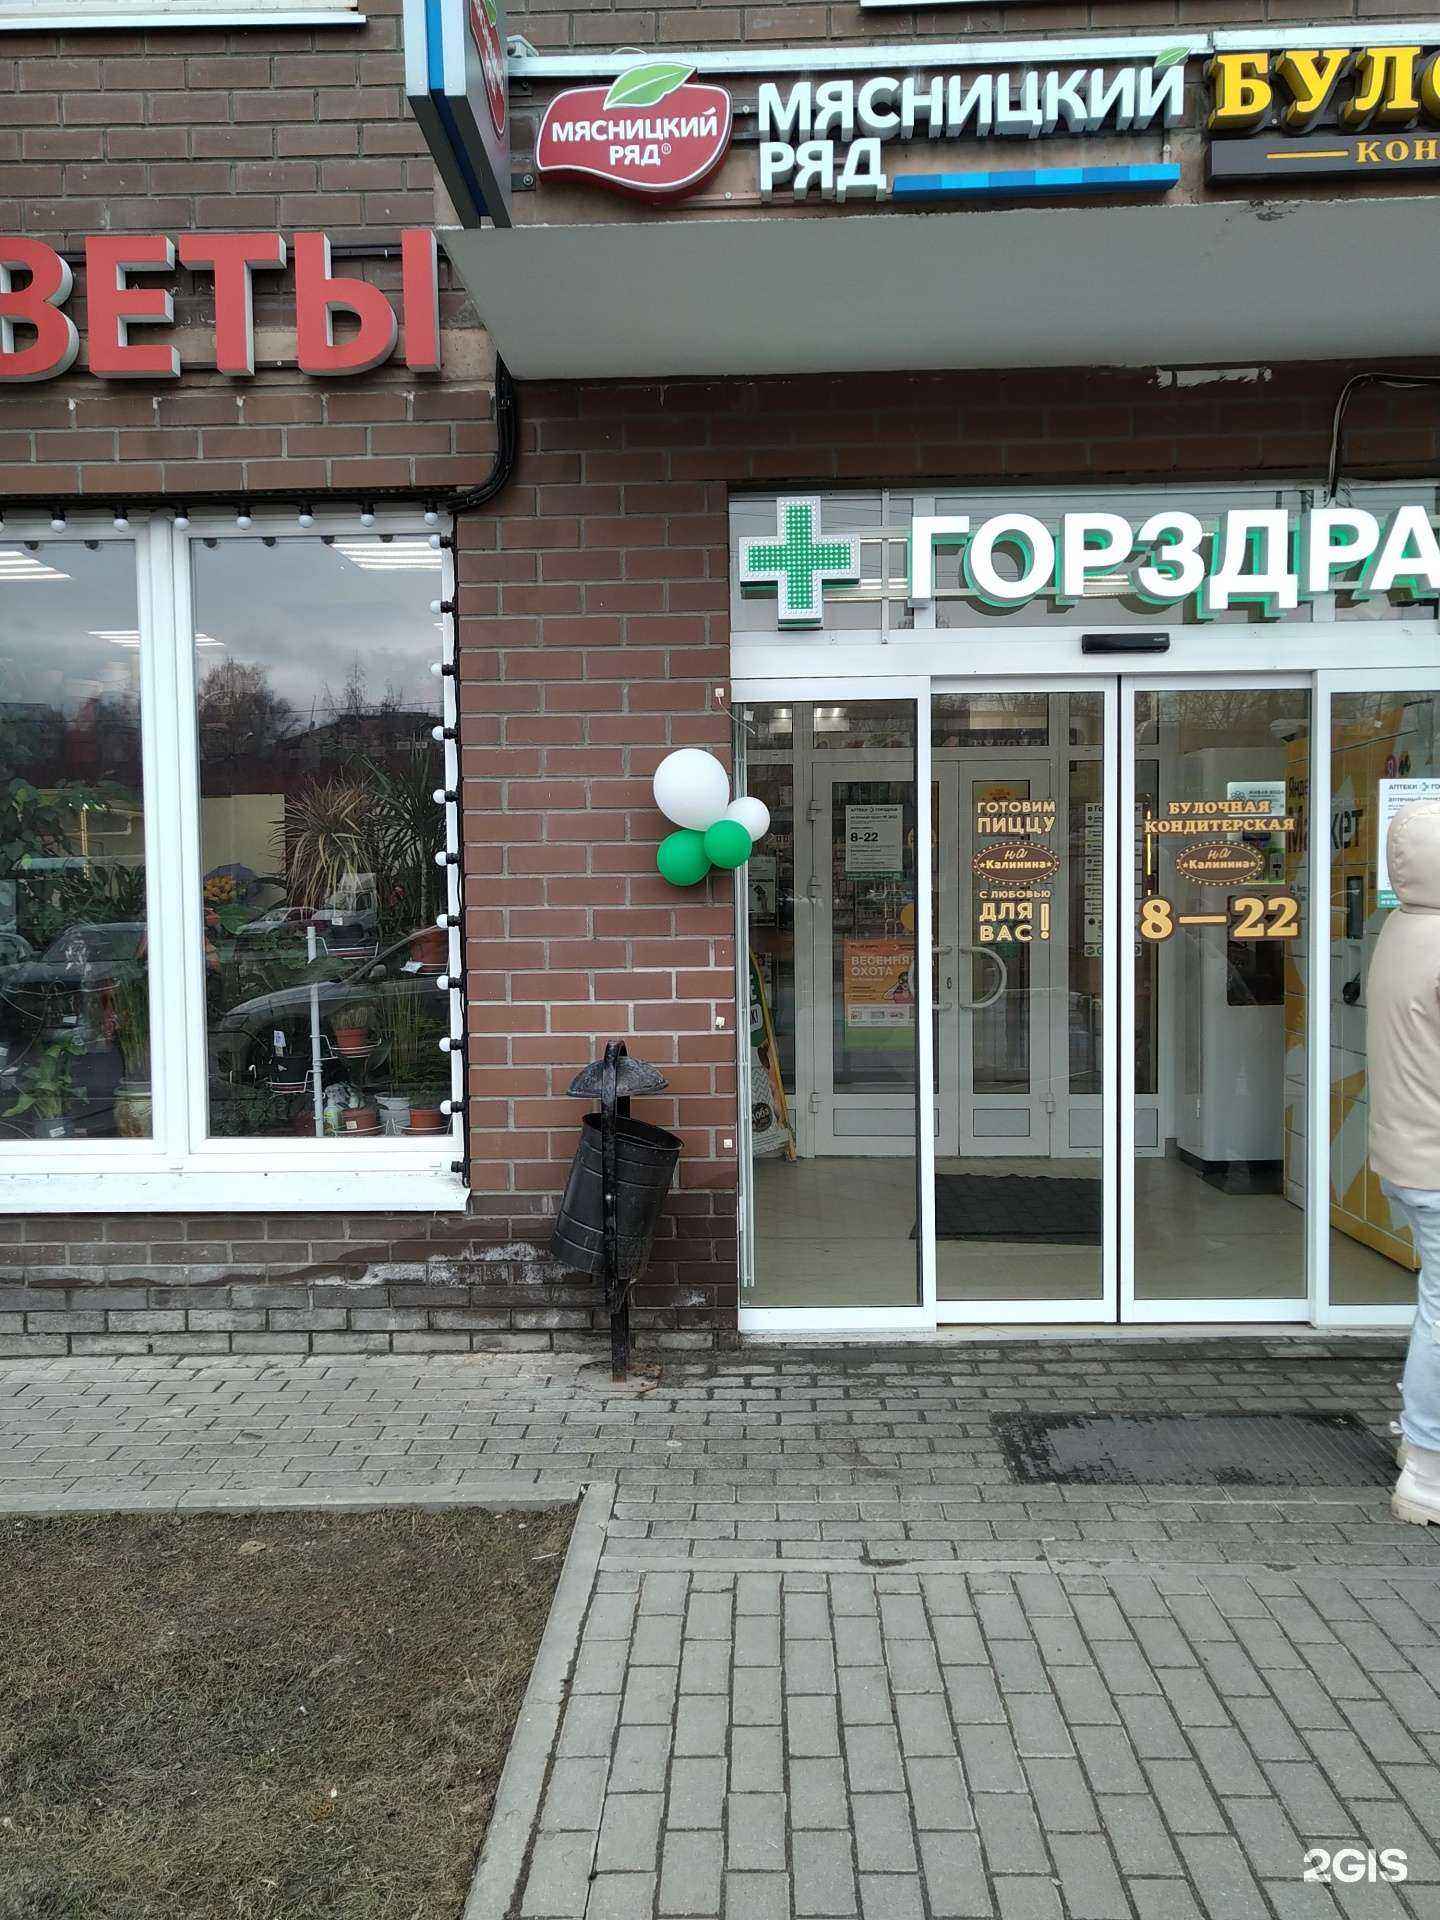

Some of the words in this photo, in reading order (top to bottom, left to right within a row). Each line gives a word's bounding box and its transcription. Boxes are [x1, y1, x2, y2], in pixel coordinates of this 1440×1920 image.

[1214, 46, 1440, 120] БУЛ
[758, 48, 1192, 138] МЯСНИЦКИЙ
[552, 106, 718, 142] МЯСНИЦКИЙ
[759, 137, 887, 200] РЯД
[911, 505, 1440, 611] ГОРЗДРА
[977, 801, 1056, 814] ГОТОВИМ
[1168, 800, 1272, 815] БУЛОЧНАЯ
[977, 816, 1056, 835] ПИЦЦУ
[1144, 818, 1296, 836] КОНДИТЕРСКАЯ
[850, 832, 879, 842] 8-22
[986, 859, 1047, 870] Калинина
[1189, 859, 1250, 870] Калинина
[991, 890, 1051, 899] ЛЮБОВЬЮ
[980, 902, 1033, 922] ДЛЯ
[851, 955, 914, 966] ВЕСЕННЯ
[851, 966, 894, 976] ОХОТА
